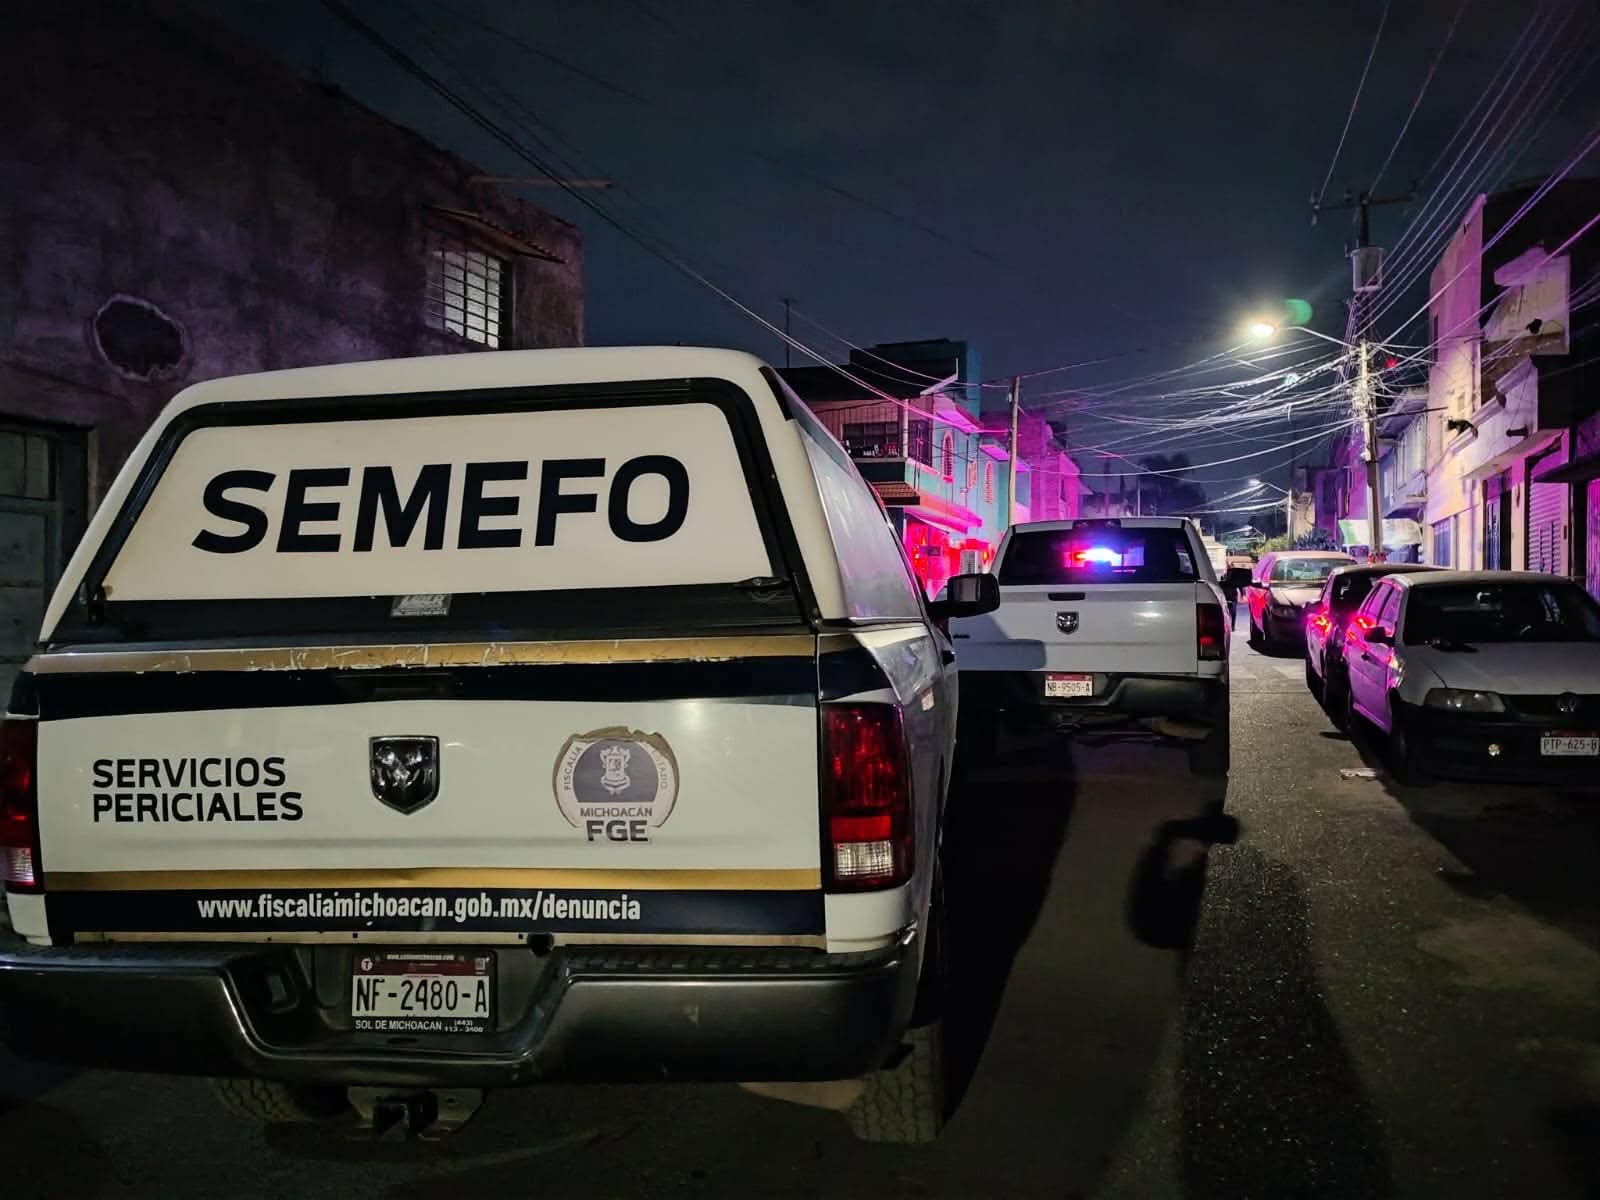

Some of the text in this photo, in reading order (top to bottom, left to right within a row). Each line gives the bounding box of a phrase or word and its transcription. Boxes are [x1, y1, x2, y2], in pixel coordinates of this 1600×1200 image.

[191, 455, 690, 554] SEMEFO
[92, 757, 286, 788] SERVICIOS
[93, 792, 303, 822] PERICIALES
[580, 807, 653, 817] MICHOACAN
[586, 820, 648, 842] FGE
[198, 891, 641, 922] www.fiscaliamichoacan.gob.mx/denuncia
[356, 978, 487, 1012] NF-2480-A
[355, 1020, 442, 1030] SOL DE MICHOACAN
